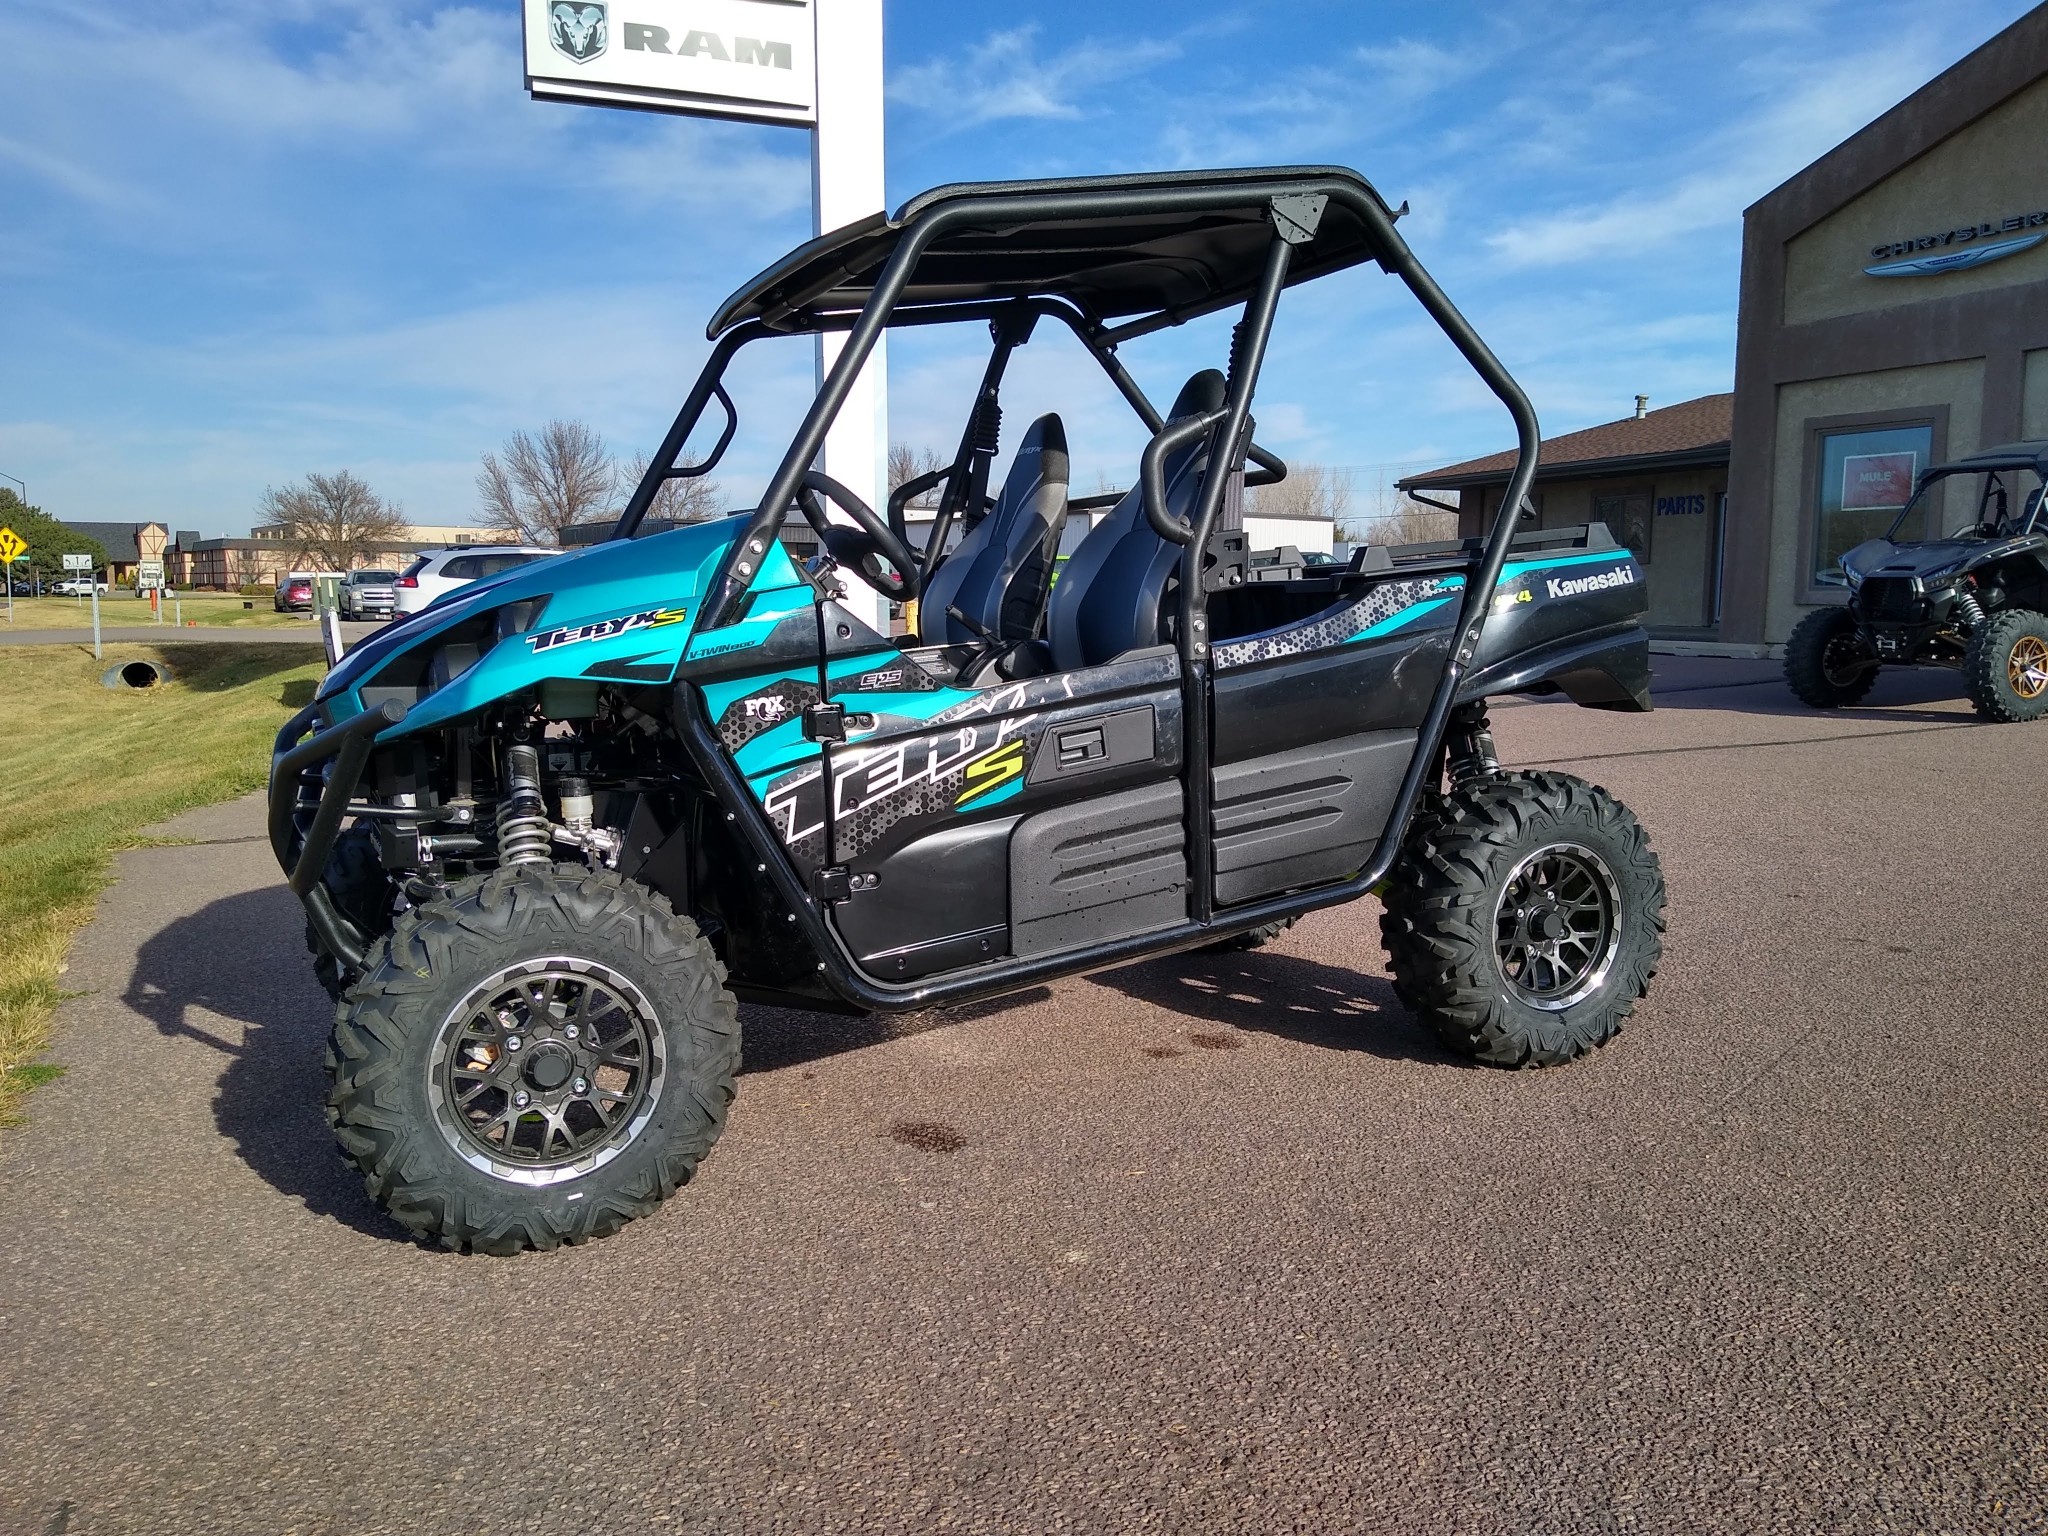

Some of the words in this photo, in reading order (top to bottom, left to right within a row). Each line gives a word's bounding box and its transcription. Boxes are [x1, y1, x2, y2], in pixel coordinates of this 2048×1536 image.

[624, 22, 792, 70] RAM
[1871, 212, 2047, 259] CHRYSLER
[1860, 471, 1892, 482] MULE
[1656, 494, 1705, 516] PARTS
[1546, 565, 1635, 598] Kawasaki
[744, 695, 786, 722] FOX
